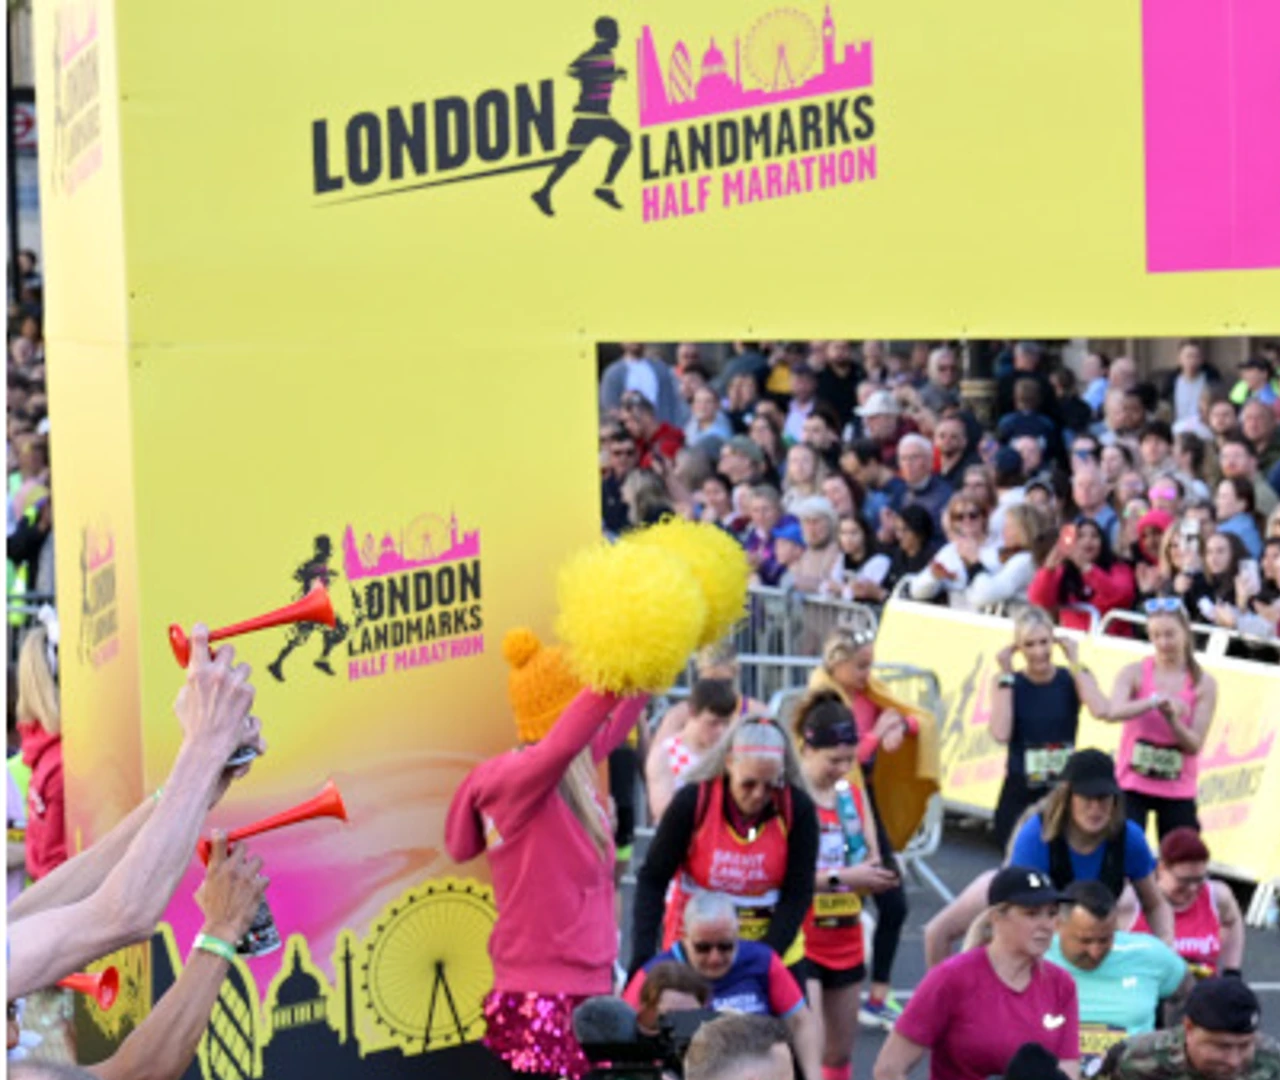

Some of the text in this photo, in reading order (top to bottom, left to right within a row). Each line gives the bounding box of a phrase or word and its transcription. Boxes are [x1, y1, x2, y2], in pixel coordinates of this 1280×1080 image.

[312, 79, 557, 196] LONDON
[641, 95, 876, 181] LANDMARKS
[642, 145, 878, 225] HALF MARATHON
[348, 603, 482, 657] LANDMARKS
[351, 558, 482, 628] LONDON
[348, 633, 485, 682] HALF MARATHON
